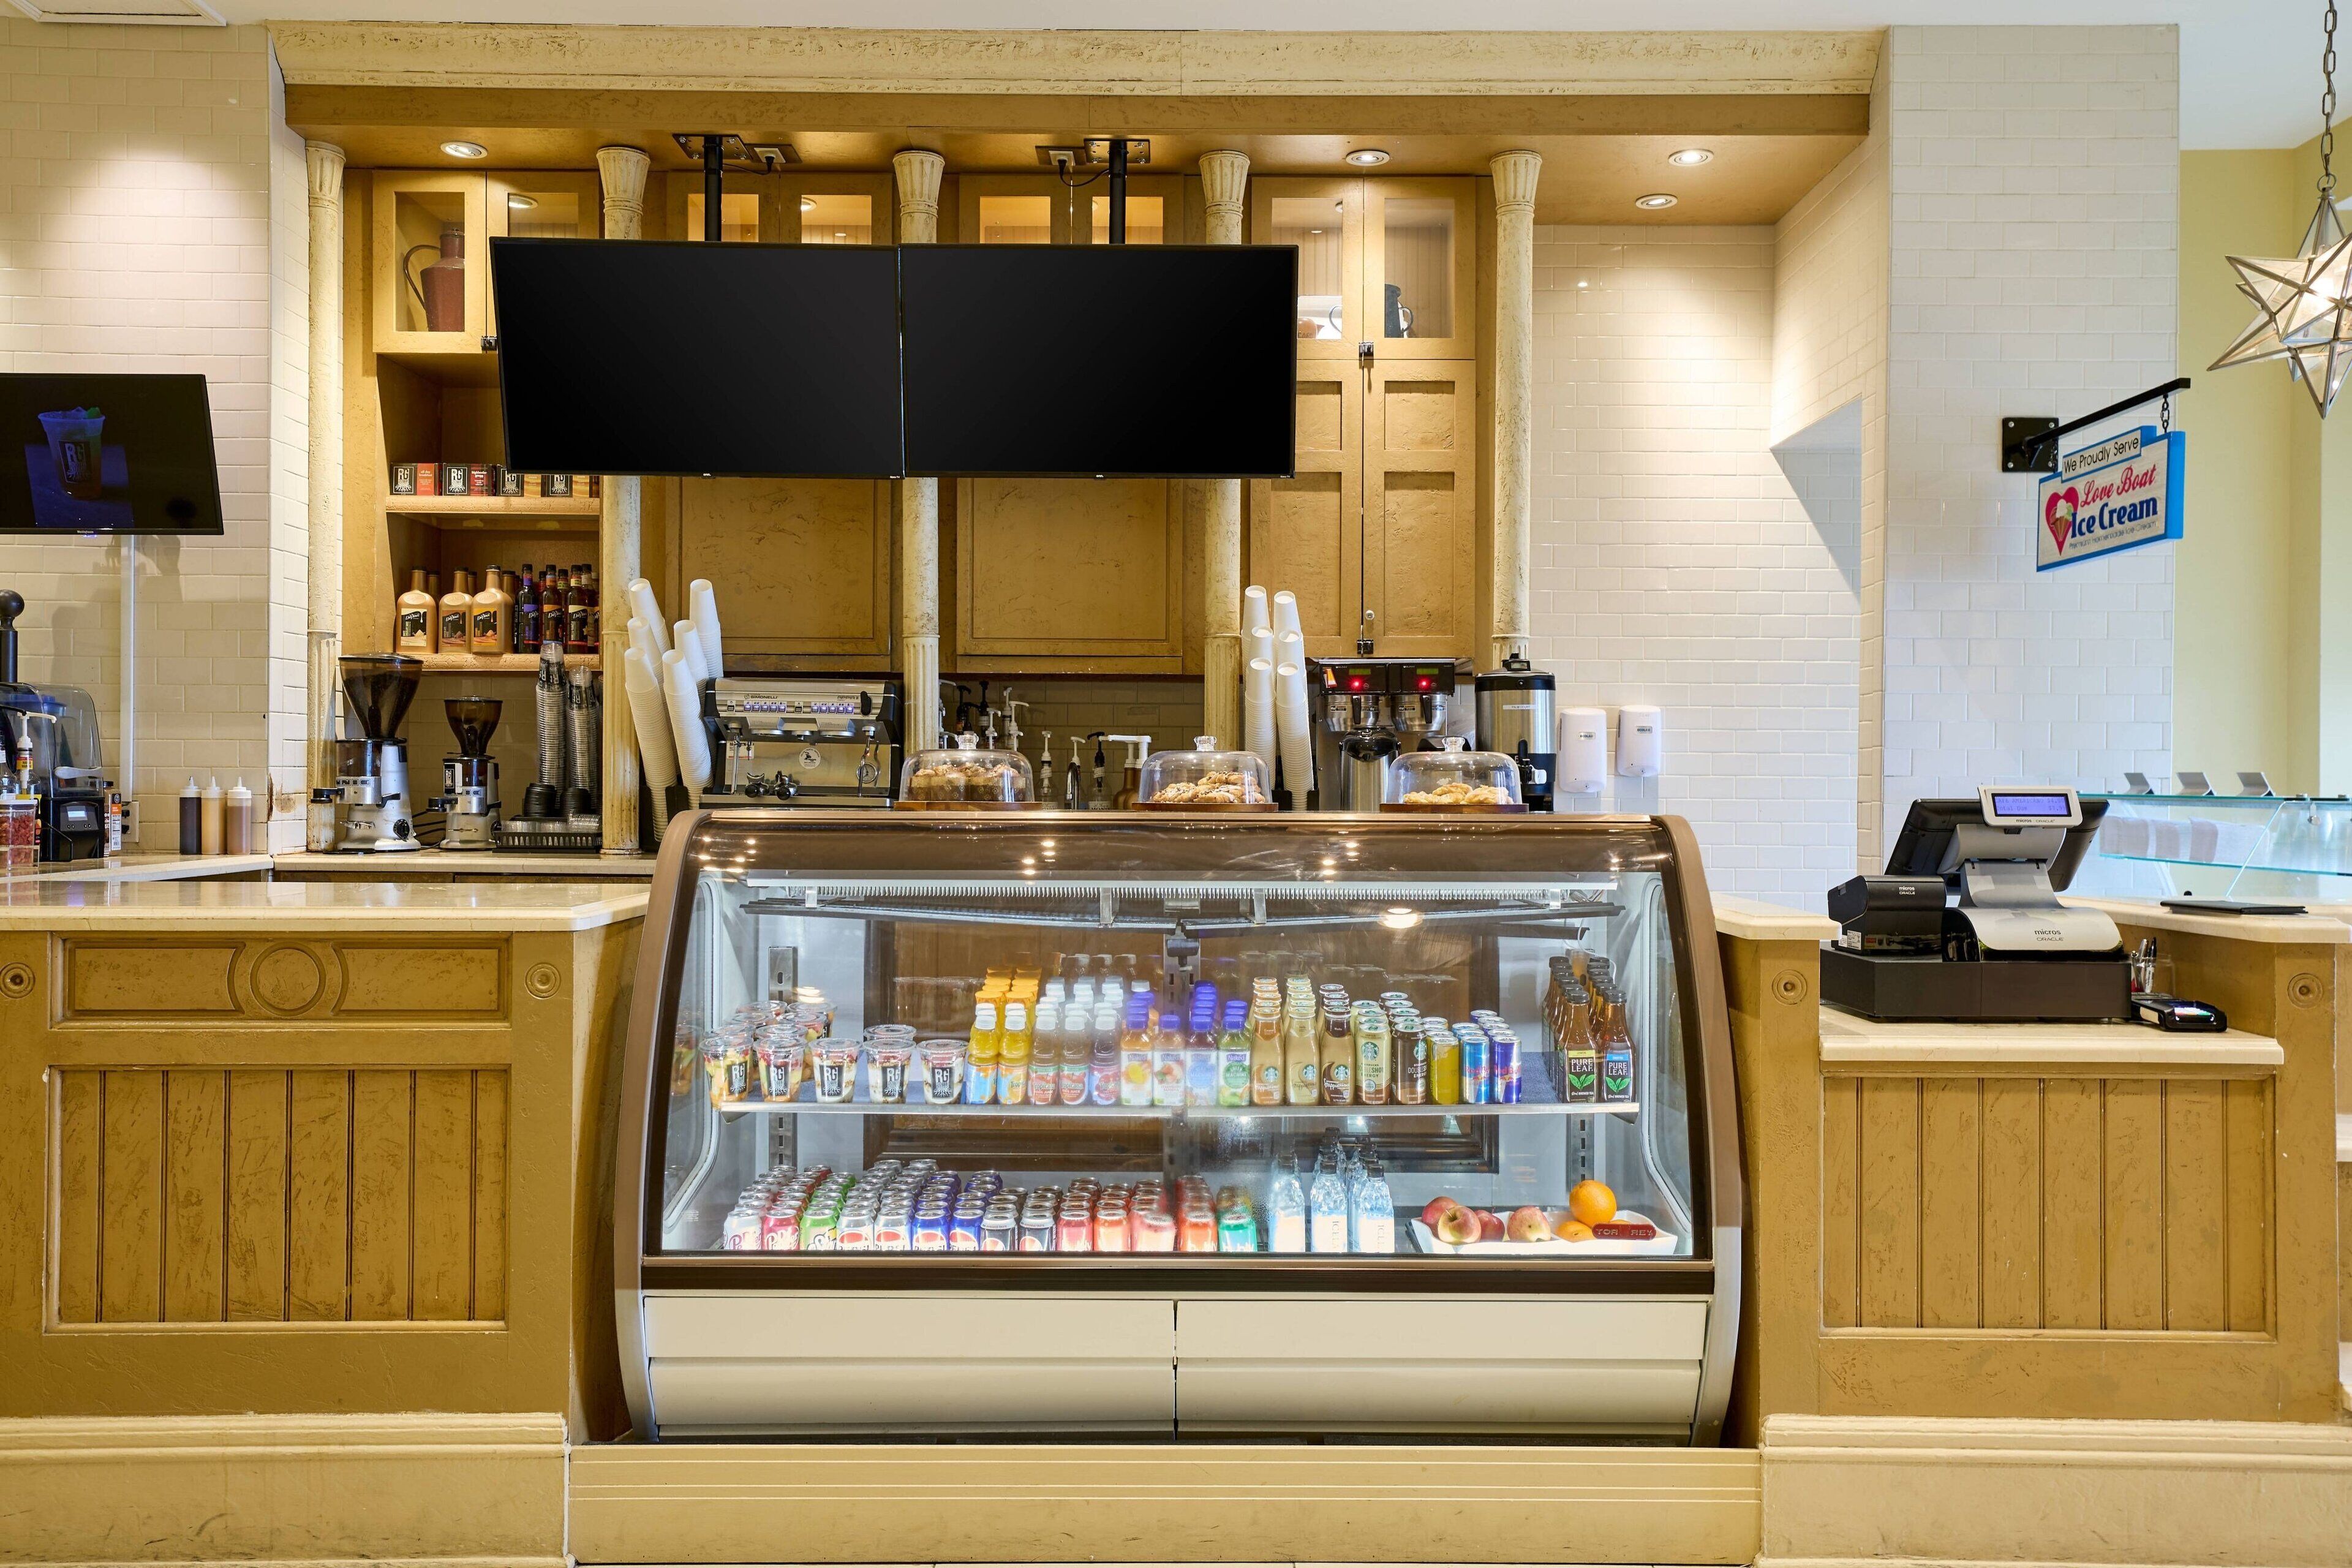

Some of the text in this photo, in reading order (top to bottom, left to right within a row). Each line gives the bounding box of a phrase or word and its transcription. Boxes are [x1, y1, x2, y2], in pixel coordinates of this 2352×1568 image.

[2064, 438, 2139, 473] We Proudly Serve
[398, 468, 410, 480] RG
[451, 469, 463, 481] RG
[2081, 464, 2157, 508] Love Boat
[2071, 497, 2158, 539] Ice Cream
[732, 1063, 745, 1079] RG
[771, 1067, 785, 1081] RG
[824, 1067, 839, 1080] RG
[888, 1067, 901, 1082] RG
[935, 1068, 949, 1082] RG
